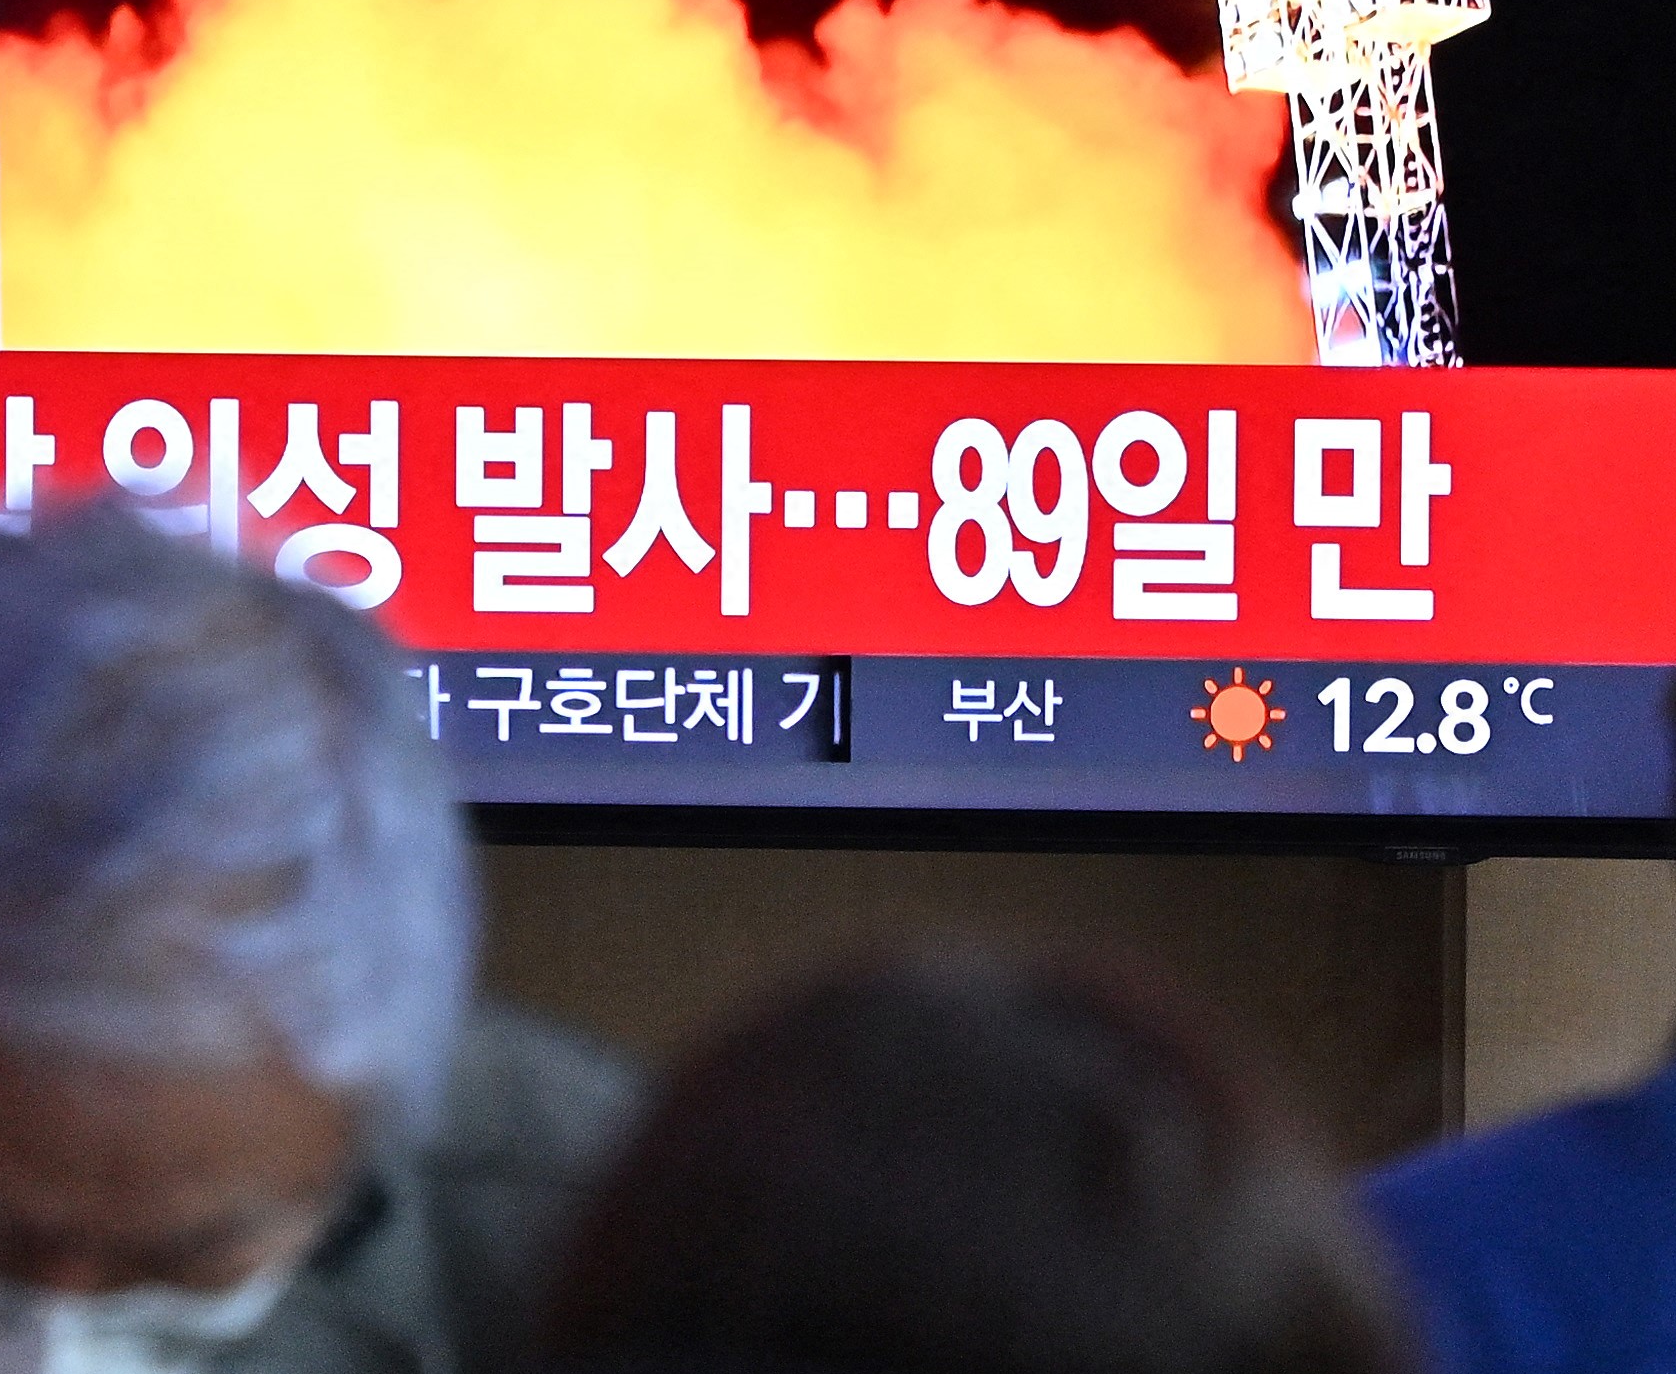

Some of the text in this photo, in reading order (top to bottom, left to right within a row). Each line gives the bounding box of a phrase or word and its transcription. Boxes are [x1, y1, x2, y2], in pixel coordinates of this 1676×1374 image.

[1294, 412, 1452, 620] 만
[467, 667, 753, 744] 구호단체
[943, 679, 1063, 742] 부산
